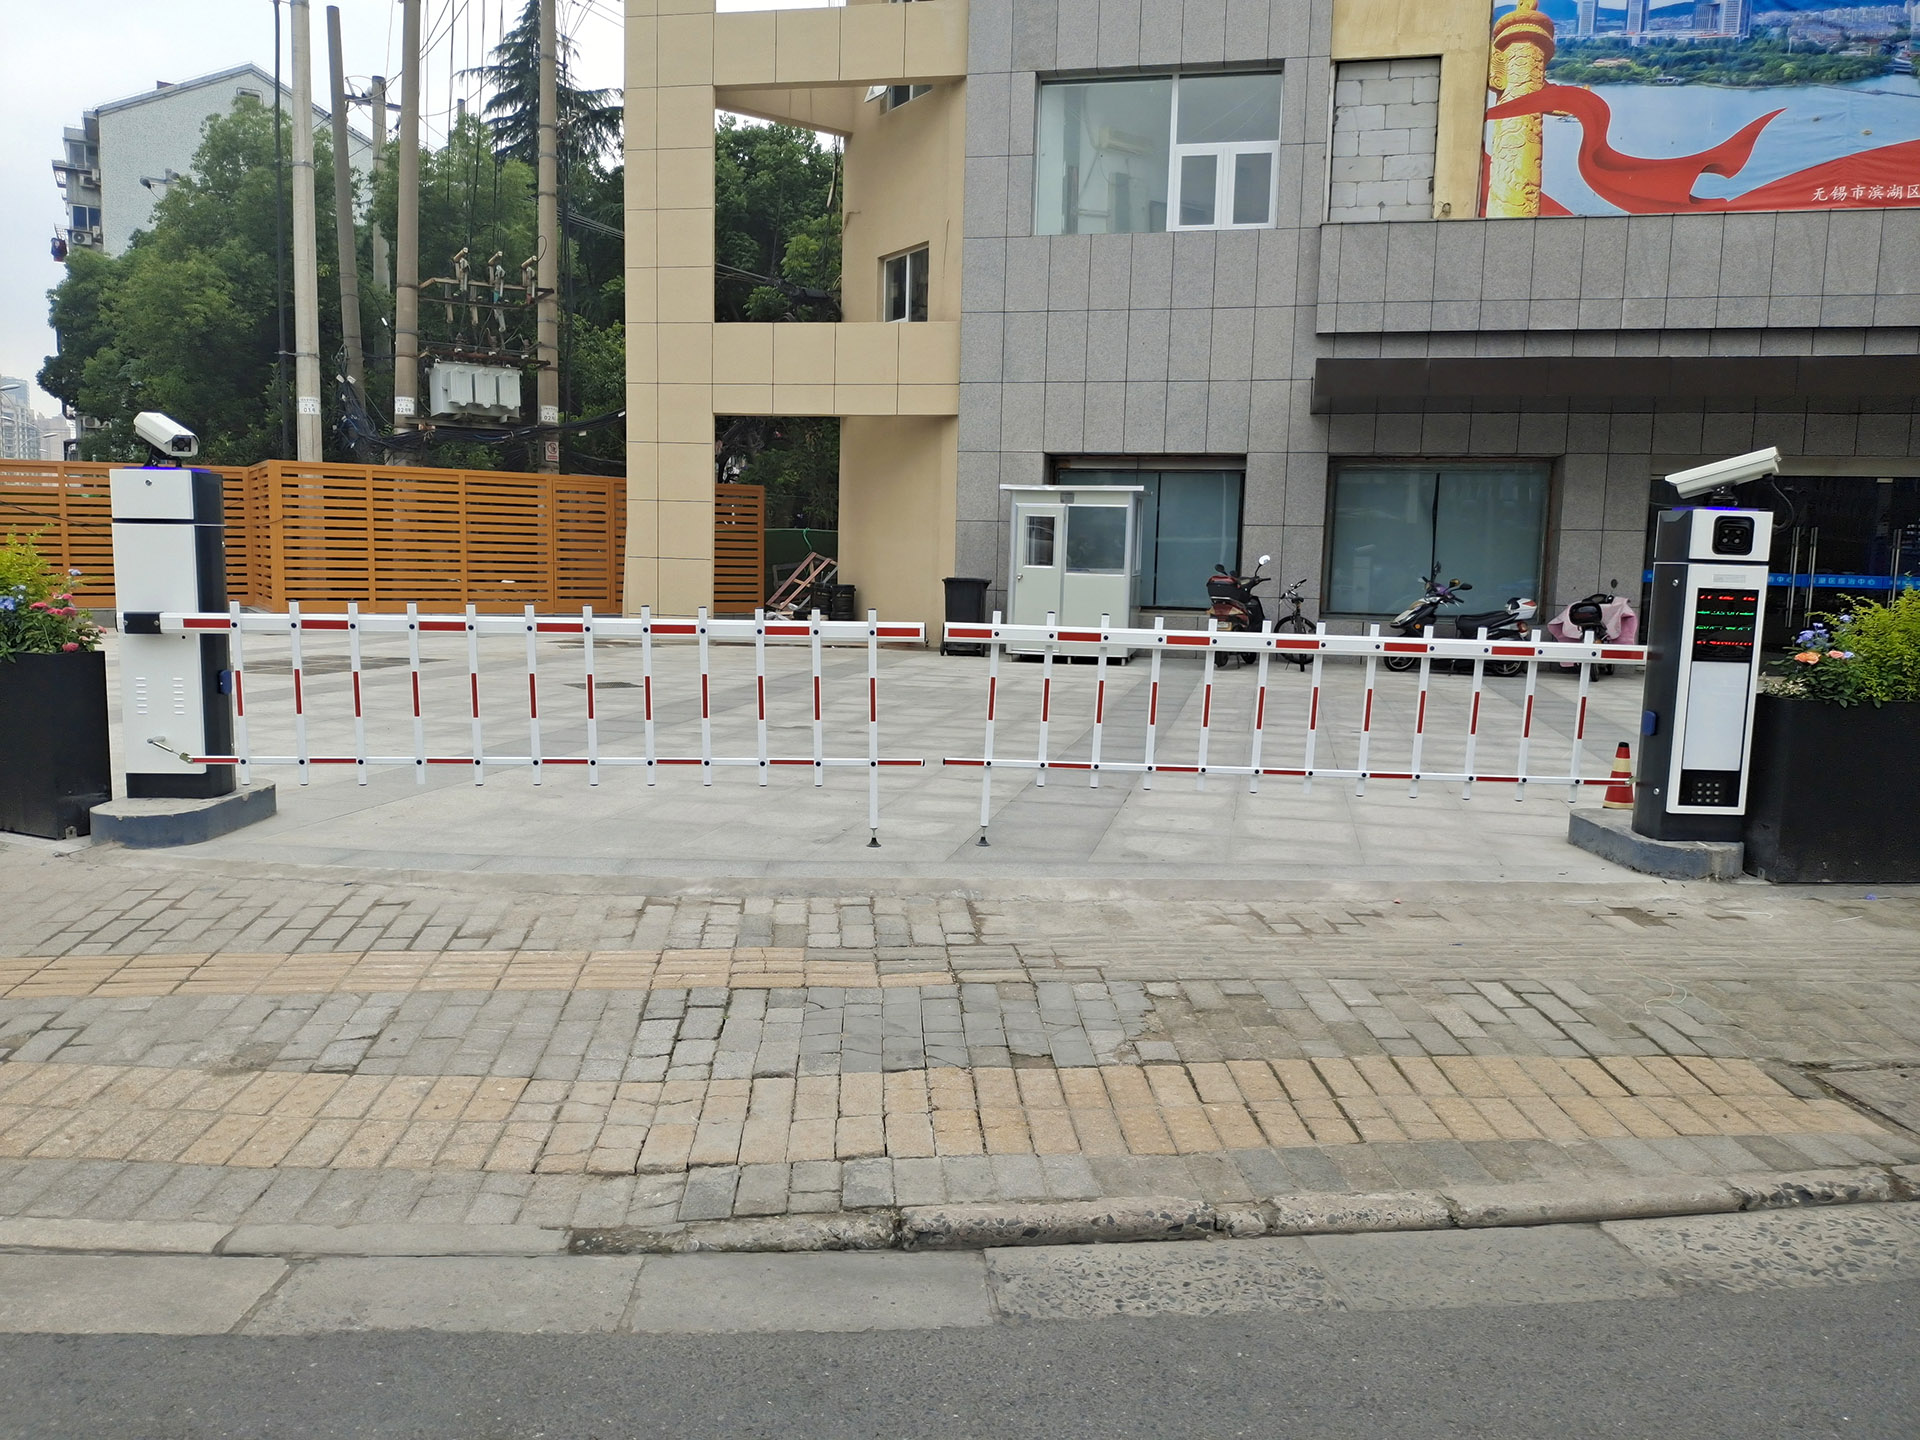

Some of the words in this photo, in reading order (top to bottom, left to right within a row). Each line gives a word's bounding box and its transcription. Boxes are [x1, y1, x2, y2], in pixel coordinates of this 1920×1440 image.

[1811, 184, 1920, 201] 无锡市滨湖区
